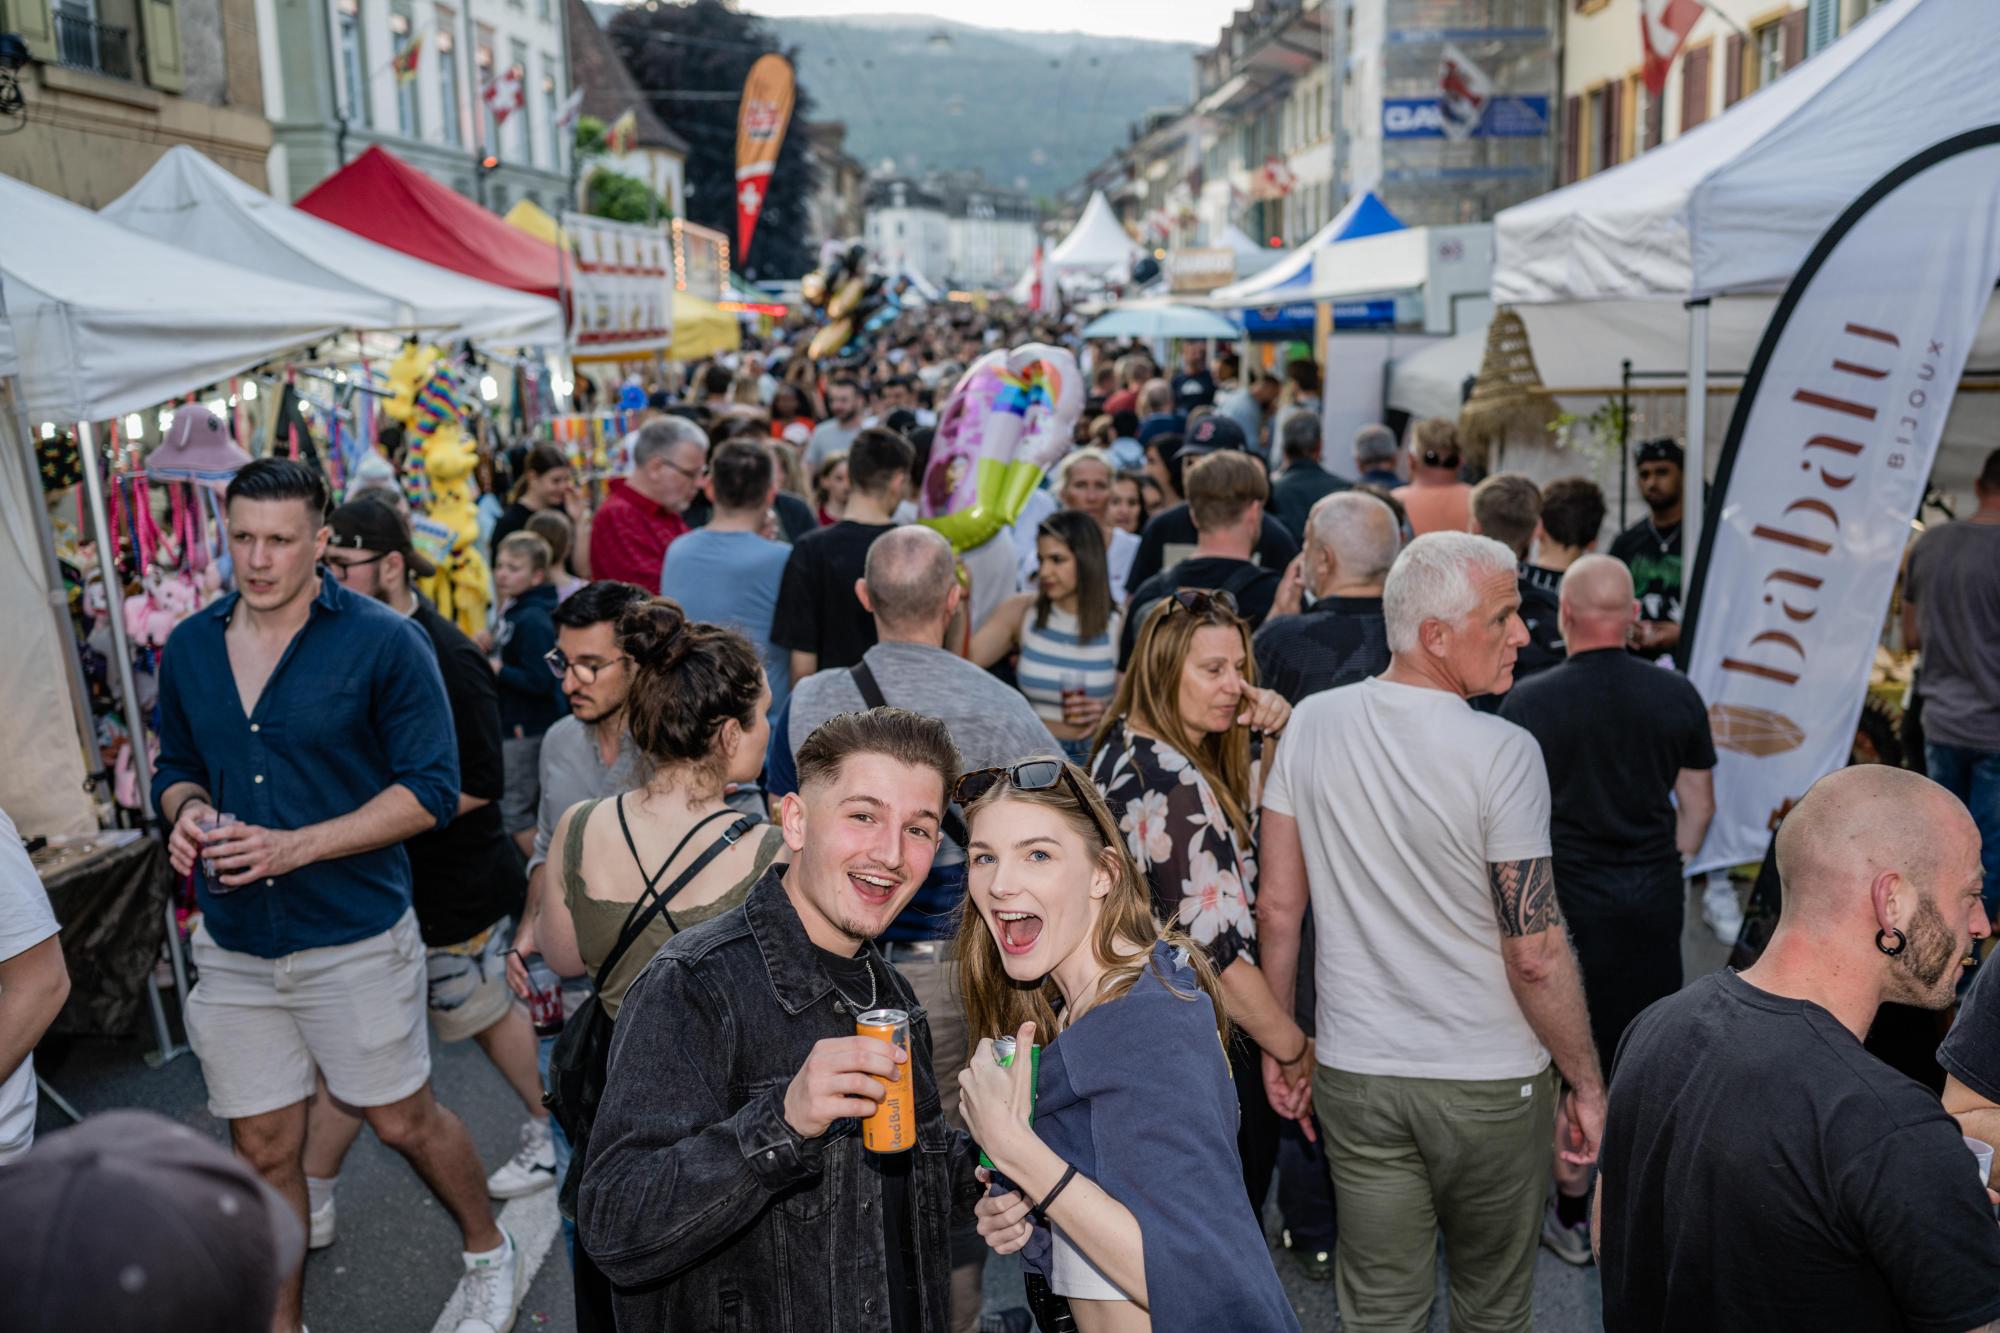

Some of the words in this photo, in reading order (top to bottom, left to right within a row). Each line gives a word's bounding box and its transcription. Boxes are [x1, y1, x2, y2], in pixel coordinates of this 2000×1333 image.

[1888, 340, 1944, 469] BIJOUX
[887, 1098, 901, 1122] Bull
[888, 1124, 902, 1148] Red
